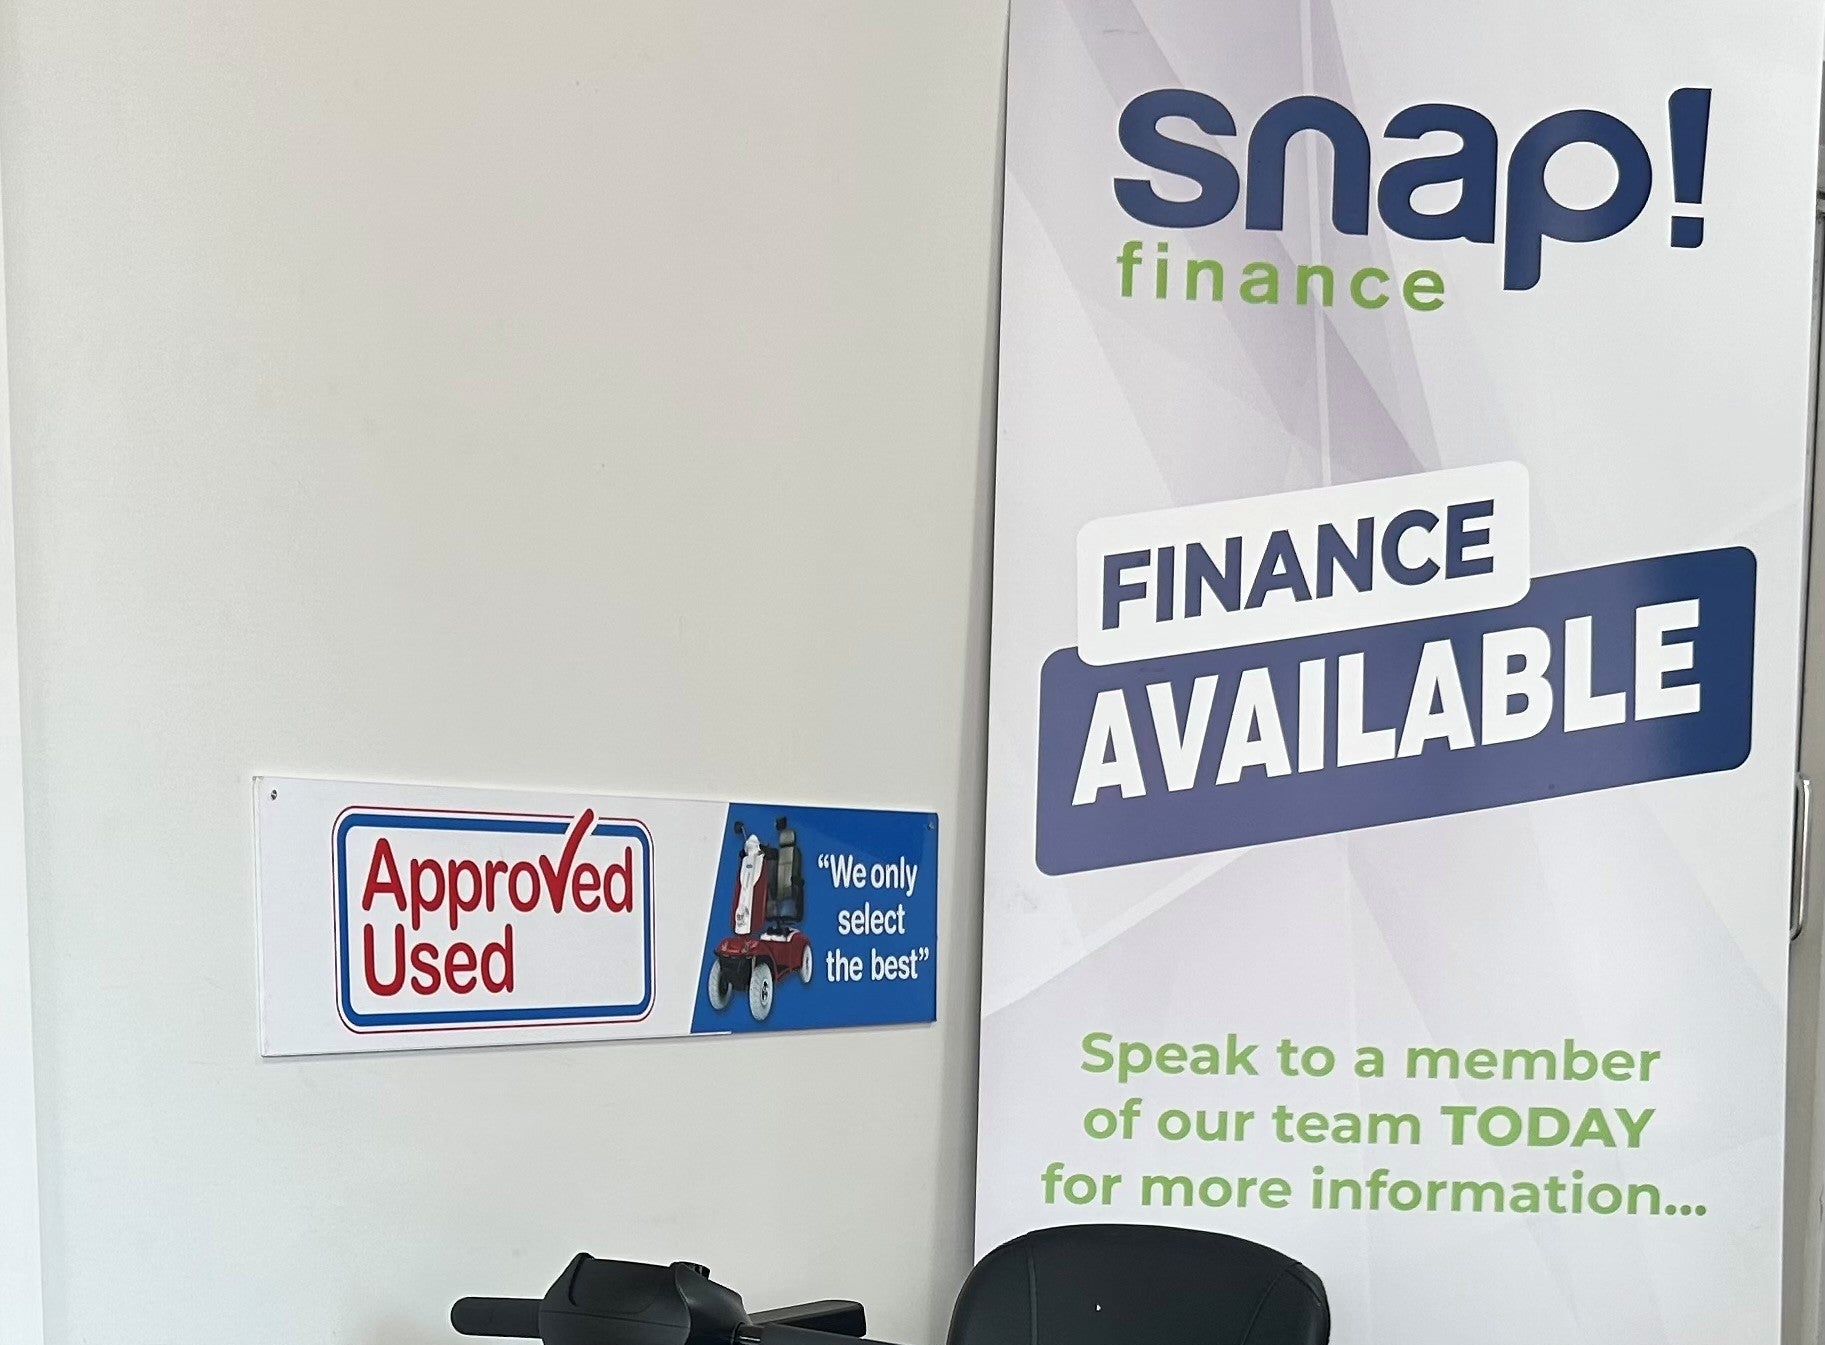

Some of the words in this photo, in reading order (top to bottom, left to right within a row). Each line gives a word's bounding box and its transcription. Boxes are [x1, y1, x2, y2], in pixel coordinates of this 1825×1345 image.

[1113, 88, 1712, 291] snap!
[1118, 240, 1445, 311] finance
[1101, 499, 1495, 631] FINANCE
[1072, 599, 1701, 806] AVAILABLE
[362, 808, 633, 930] Approved
[871, 857, 917, 896] only
[839, 902, 904, 934] select
[363, 922, 514, 996] Used
[827, 949, 862, 981] the
[871, 946, 930, 982] best”
[1082, 1032, 1256, 1082] Speak
[1278, 1040, 1336, 1077] to
[1355, 1046, 1385, 1077] a
[1407, 1039, 1660, 1081] member
[1084, 1098, 1142, 1139] of
[1158, 1109, 1254, 1142] our
[1273, 1105, 1421, 1144] team
[1441, 1105, 1654, 1148] TODAY
[1041, 1162, 1122, 1204] for
[1142, 1176, 1292, 1208] more
[1312, 1165, 1706, 1216] information...
